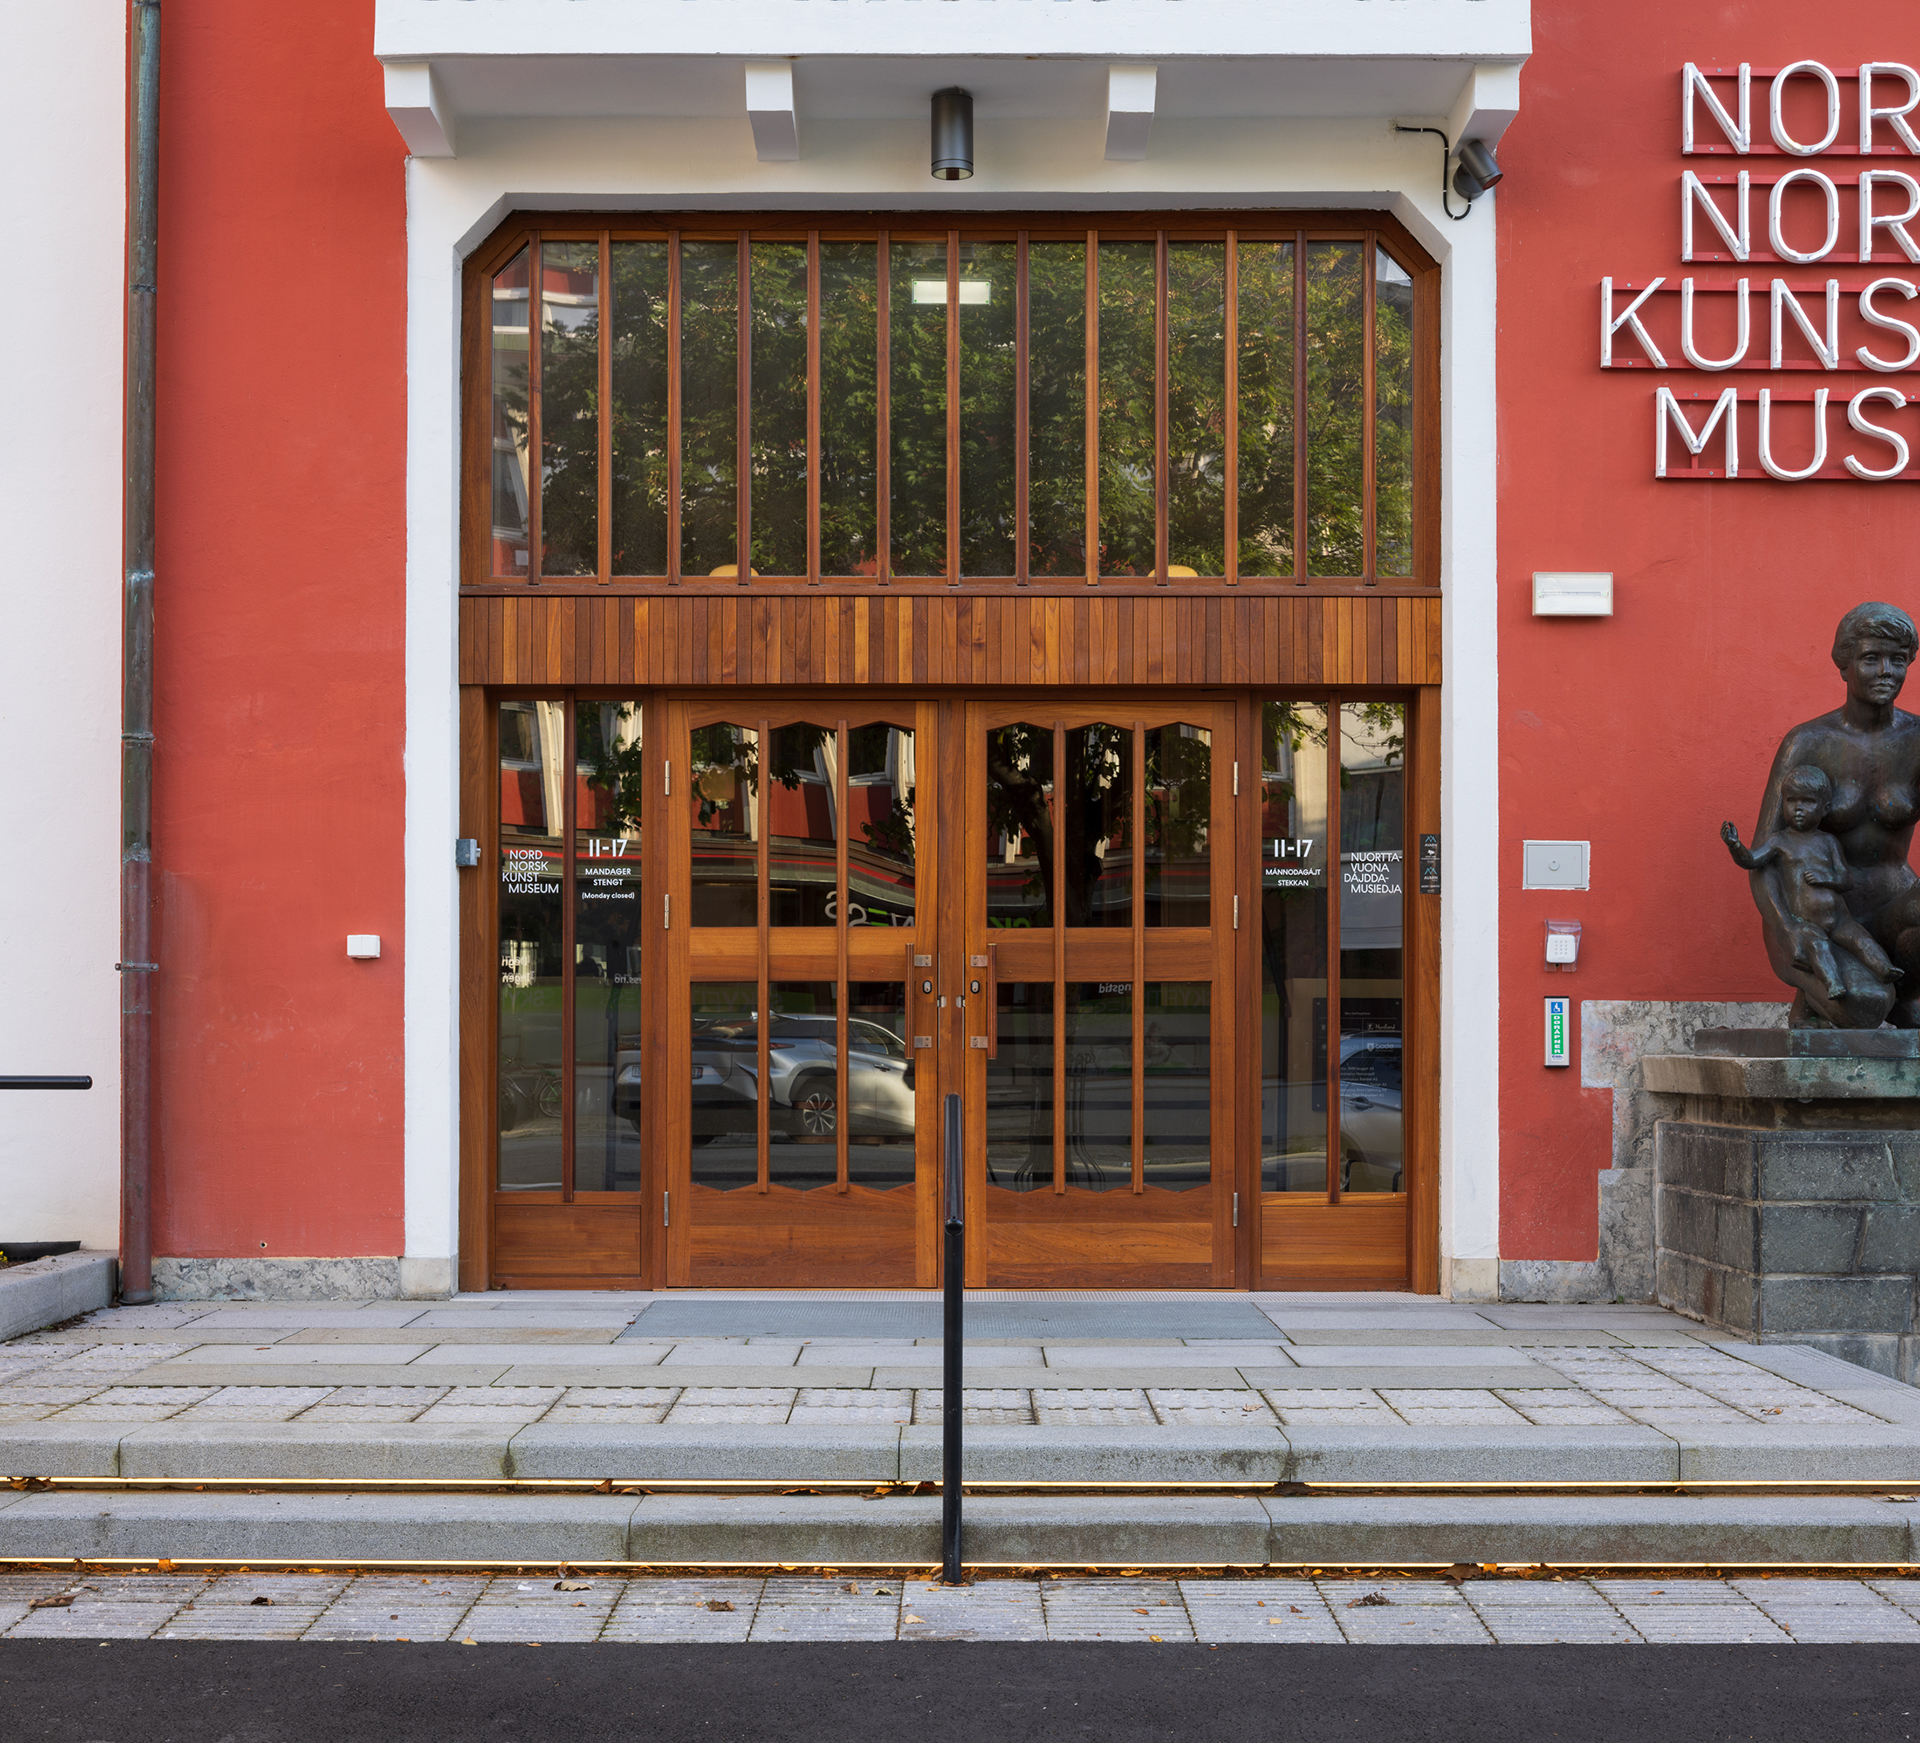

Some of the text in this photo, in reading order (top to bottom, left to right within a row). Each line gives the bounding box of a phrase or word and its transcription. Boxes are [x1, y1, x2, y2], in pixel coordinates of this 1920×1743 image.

[1682, 60, 1920, 156] NOR
[1681, 168, 1920, 264] NOR
[1600, 276, 1920, 372] KUNS
[1655, 387, 1909, 481] MUS
[509, 849, 543, 860] NORD
[1351, 852, 1403, 862] NUORTTA-
[509, 860, 549, 871] NORSK
[1350, 863, 1390, 872] VUONA
[585, 867, 632, 875] MANDAGER
[502, 872, 540, 882] KUNST
[593, 878, 624, 886] STENGT
[1277, 879, 1309, 887] STEKKAN
[508, 883, 559, 894] MUSEUM
[1351, 884, 1403, 894] MUSIEDJA
[581, 891, 635, 900] (Monday closed)
